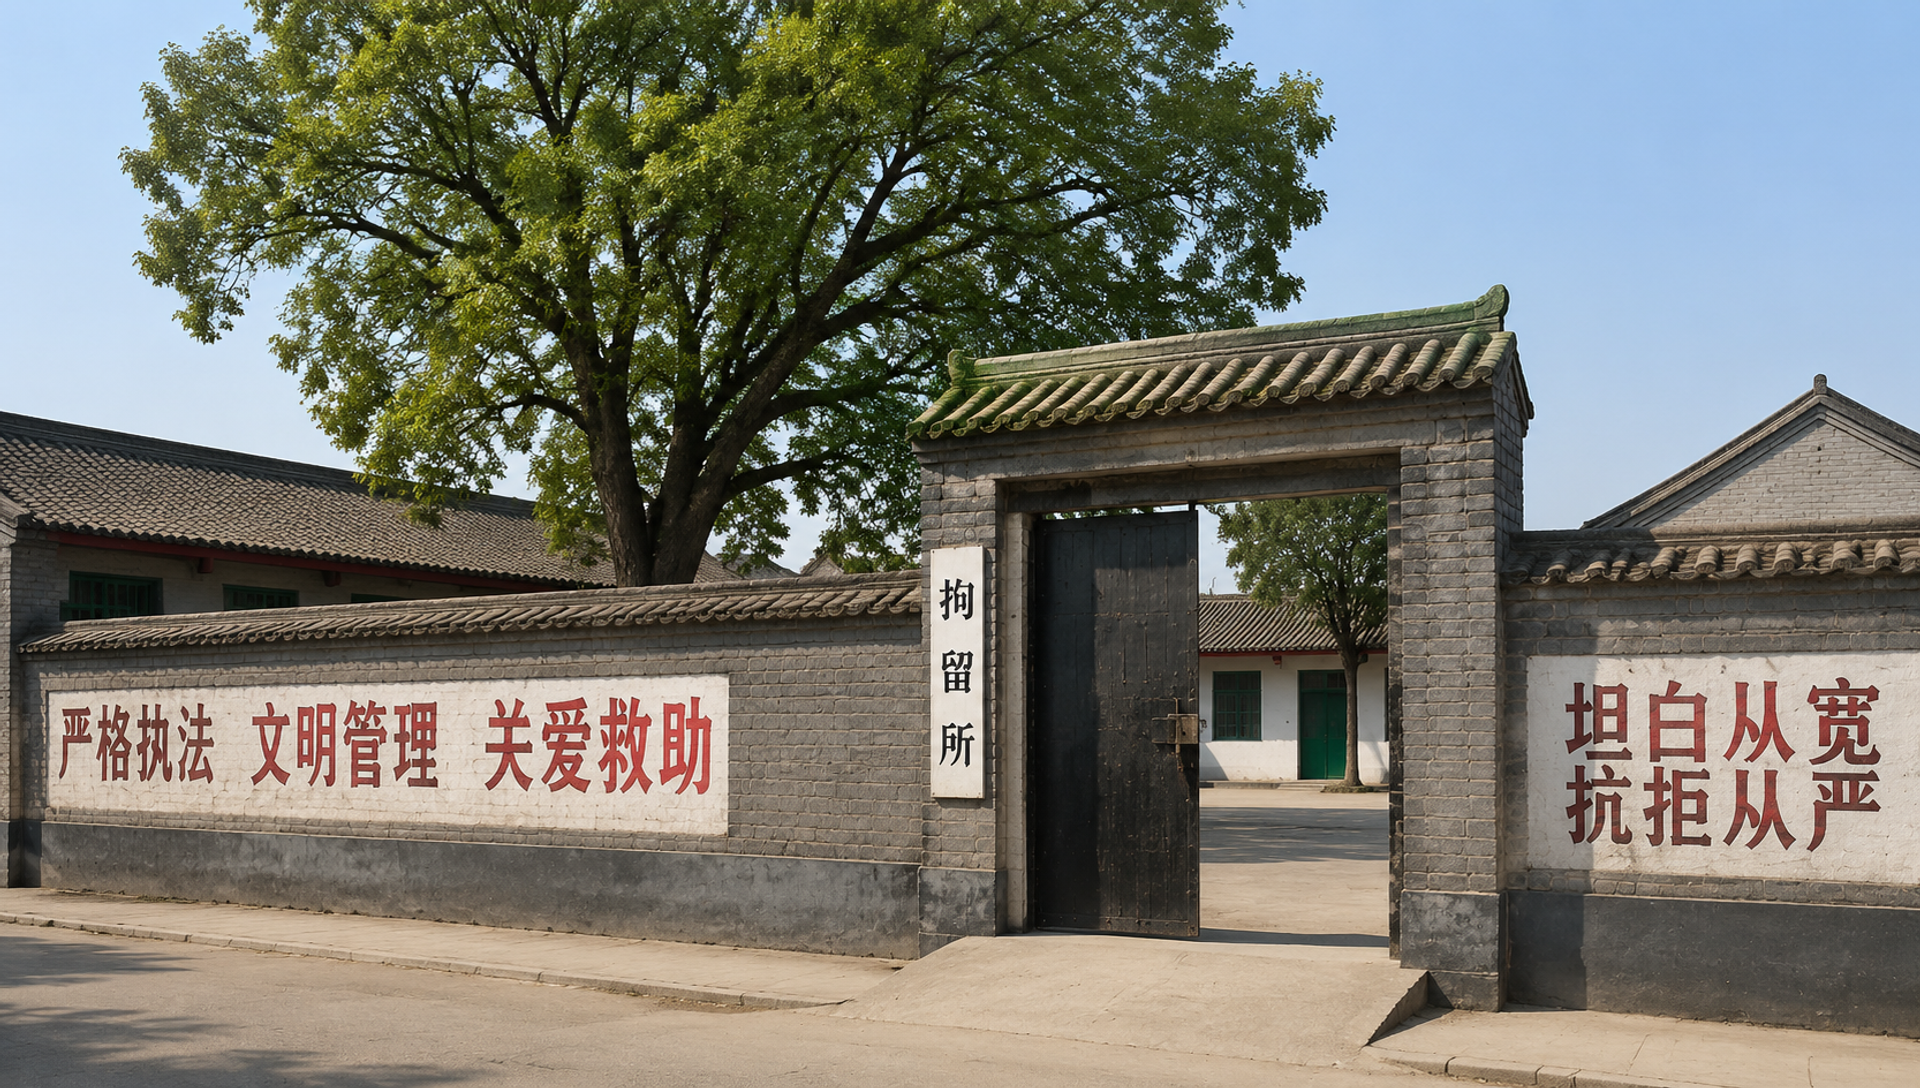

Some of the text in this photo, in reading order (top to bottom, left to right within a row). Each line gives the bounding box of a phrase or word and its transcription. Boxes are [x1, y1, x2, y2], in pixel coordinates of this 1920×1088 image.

[939, 578, 975, 767] 拘留所
[59, 696, 713, 795] 严格执法 文明管理 关爱救助
[1565, 677, 1882, 765] 坦白从宽
[1565, 764, 1882, 851] 抗拒从严
